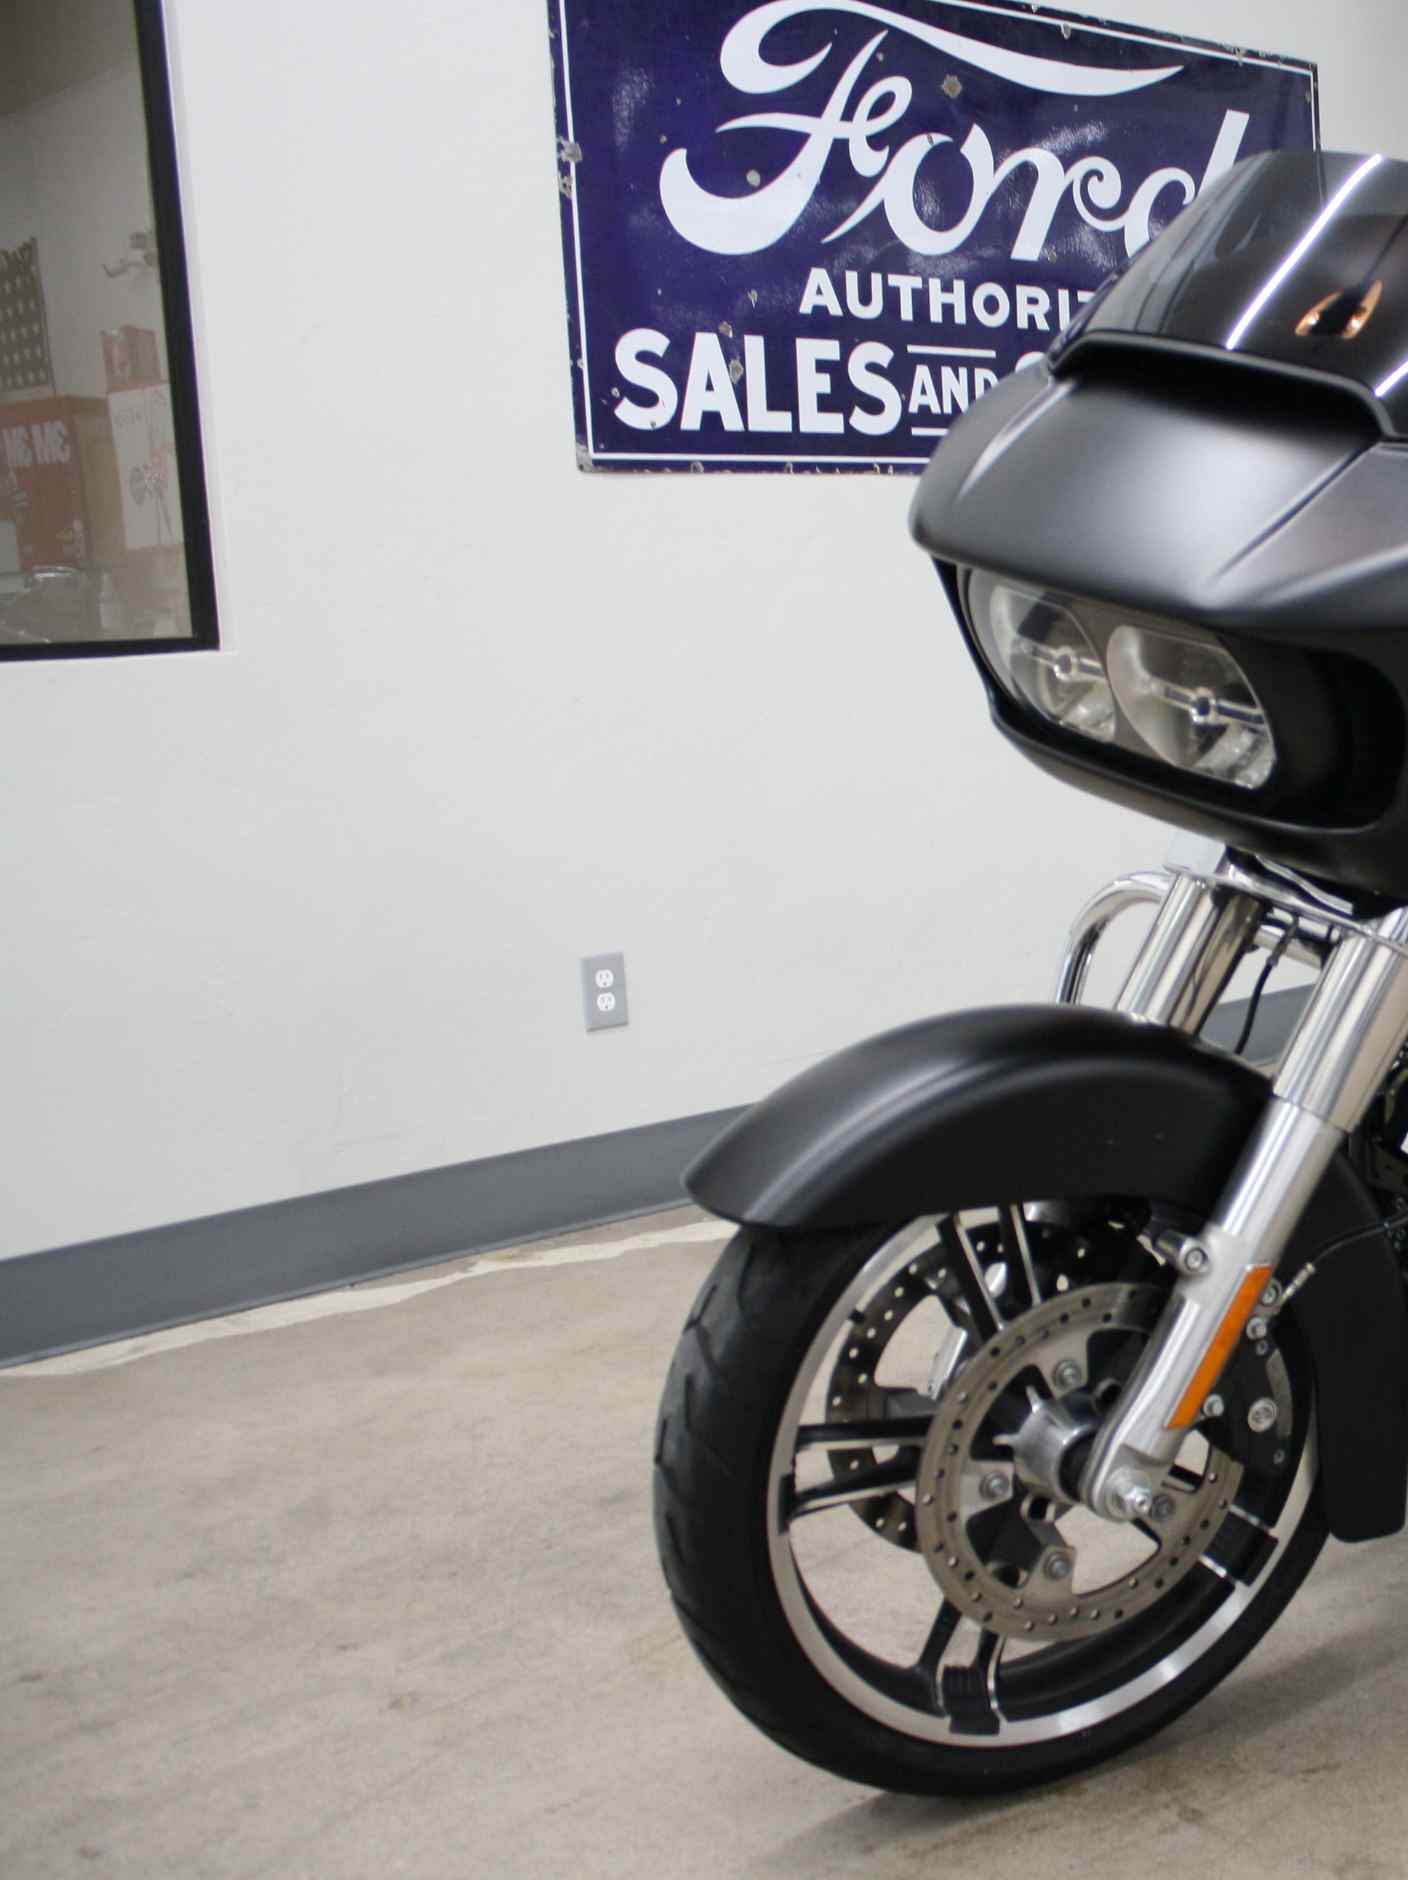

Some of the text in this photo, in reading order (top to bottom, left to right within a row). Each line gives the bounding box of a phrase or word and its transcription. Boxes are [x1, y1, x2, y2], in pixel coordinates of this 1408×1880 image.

[660, 0, 1250, 262] Ford
[799, 267, 1097, 332] AUTHORI
[613, 327, 903, 436] SALES
